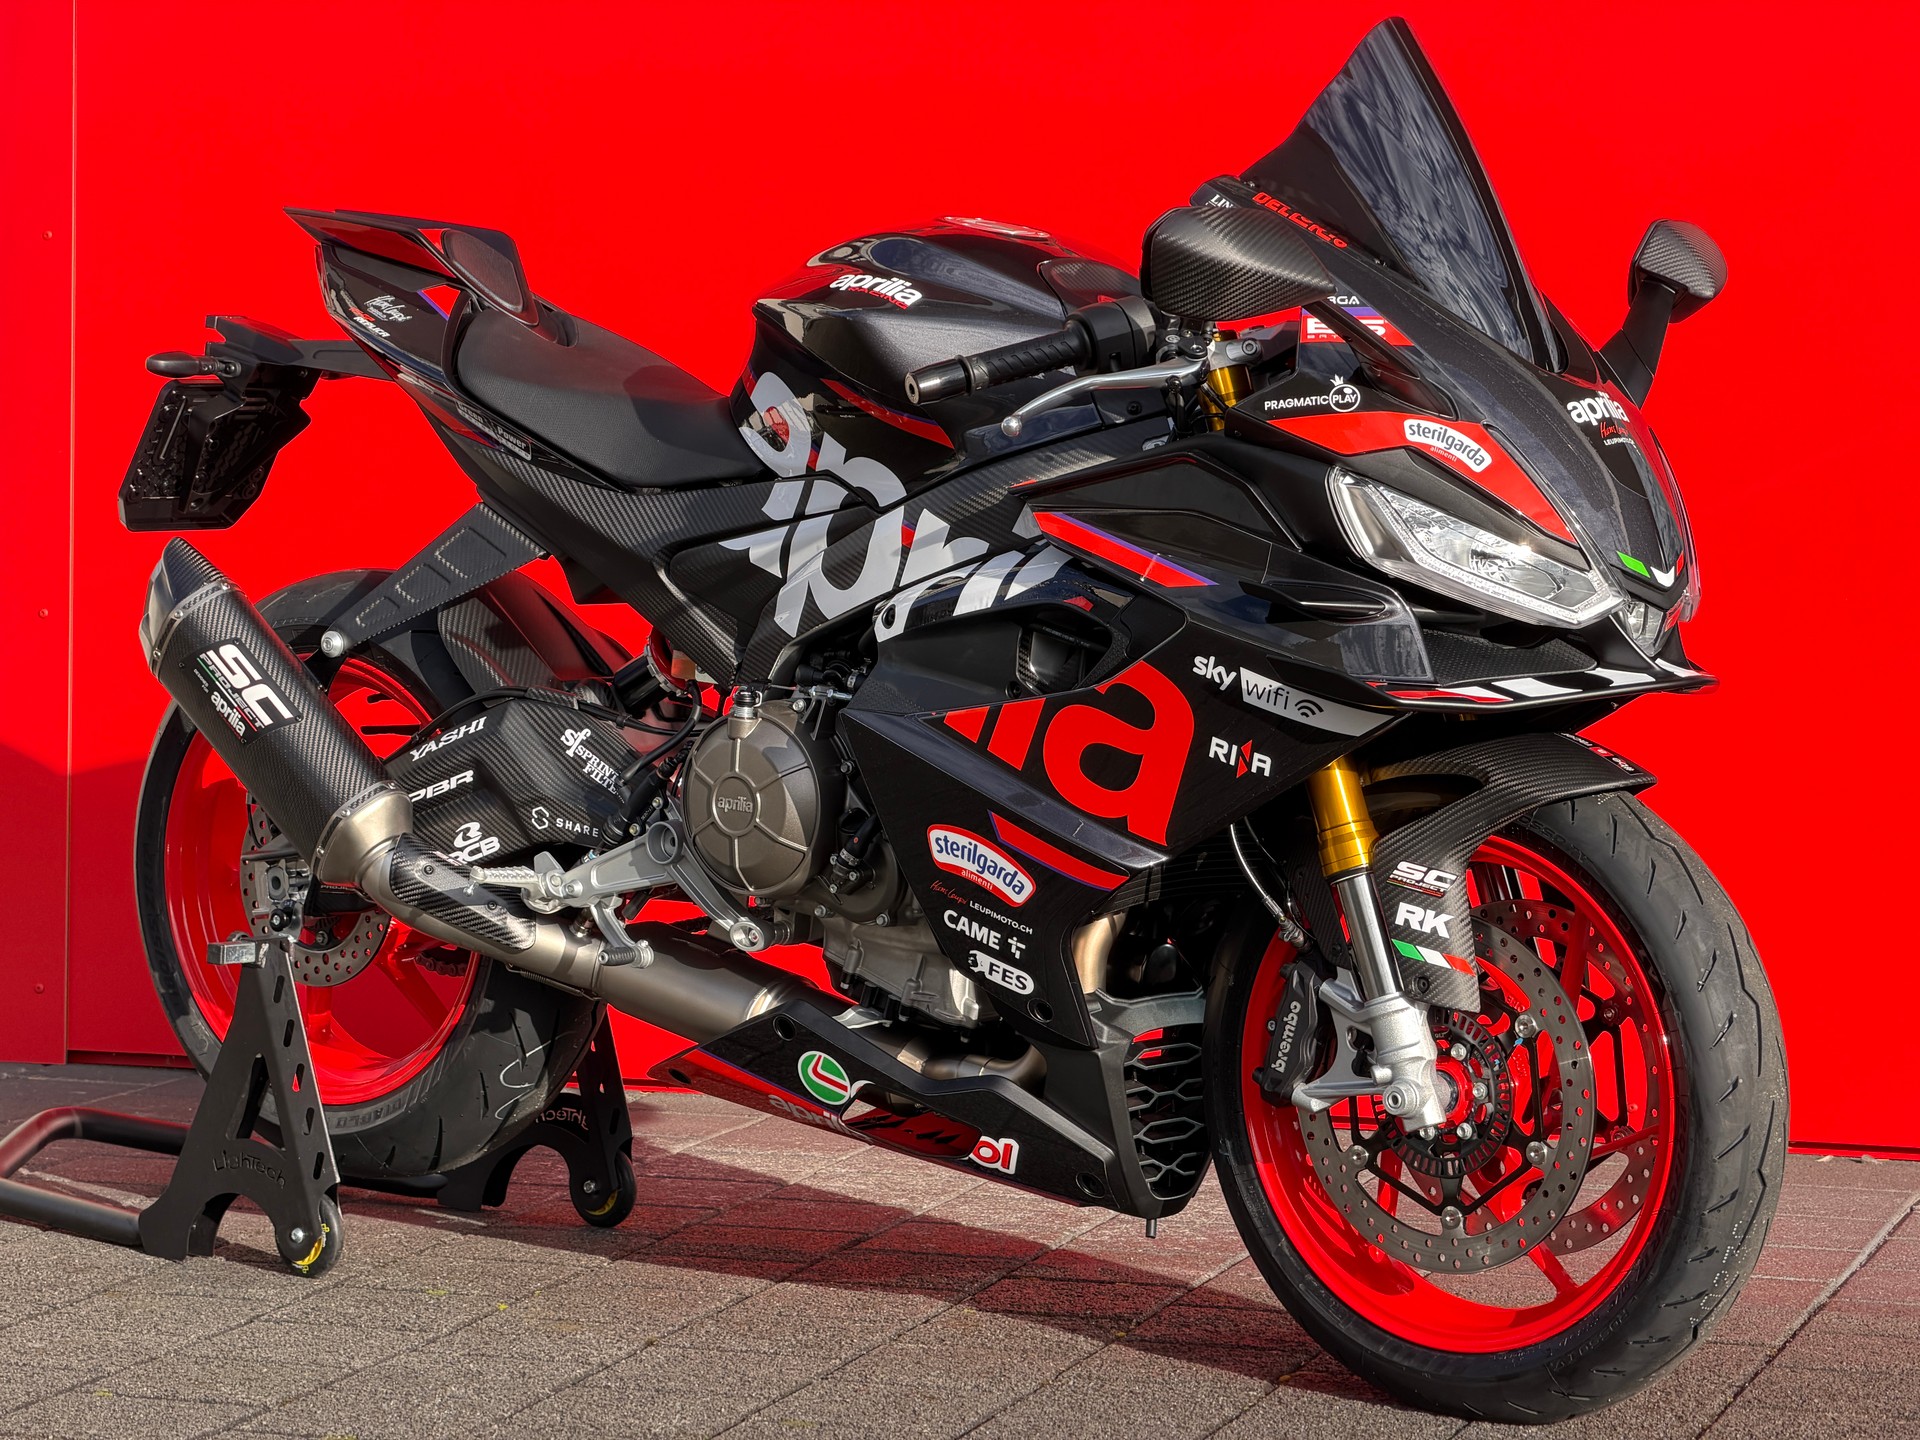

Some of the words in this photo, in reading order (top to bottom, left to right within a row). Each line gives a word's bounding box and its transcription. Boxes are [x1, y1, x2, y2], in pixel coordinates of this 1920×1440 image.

[829, 273, 923, 307] aprilia
[1264, 395, 1329, 411] PRAGMATIC
[1332, 393, 1357, 404] PLAY
[1566, 390, 1630, 426] aprilia
[497, 426, 527, 449] Power
[1408, 422, 1486, 467] sterilgarda
[1429, 445, 1458, 463] alimenti
[199, 652, 265, 729] PROJECT
[206, 643, 294, 727] SC
[1192, 655, 1237, 691] sky
[1245, 679, 1291, 710] wifi
[210, 691, 247, 737] aprilia
[409, 716, 488, 762] YASHI
[574, 744, 620, 781] SPRINT
[1208, 736, 1272, 779] RINA
[408, 769, 475, 803] PBR
[582, 762, 621, 797] FILTE
[717, 795, 754, 813] aprilia
[555, 817, 600, 838] SHARE
[446, 836, 501, 867] RCB
[934, 834, 1025, 896] sterilgarda
[961, 868, 994, 891] alimenti
[1388, 873, 1448, 893] PROJECT
[1392, 860, 1458, 889] SC
[943, 909, 1002, 951] CAME
[969, 900, 1034, 935] LEUPIMOTO.CH
[1394, 901, 1456, 939] RK
[988, 960, 1029, 992] FES
[1270, 1000, 1302, 1074] brembo
